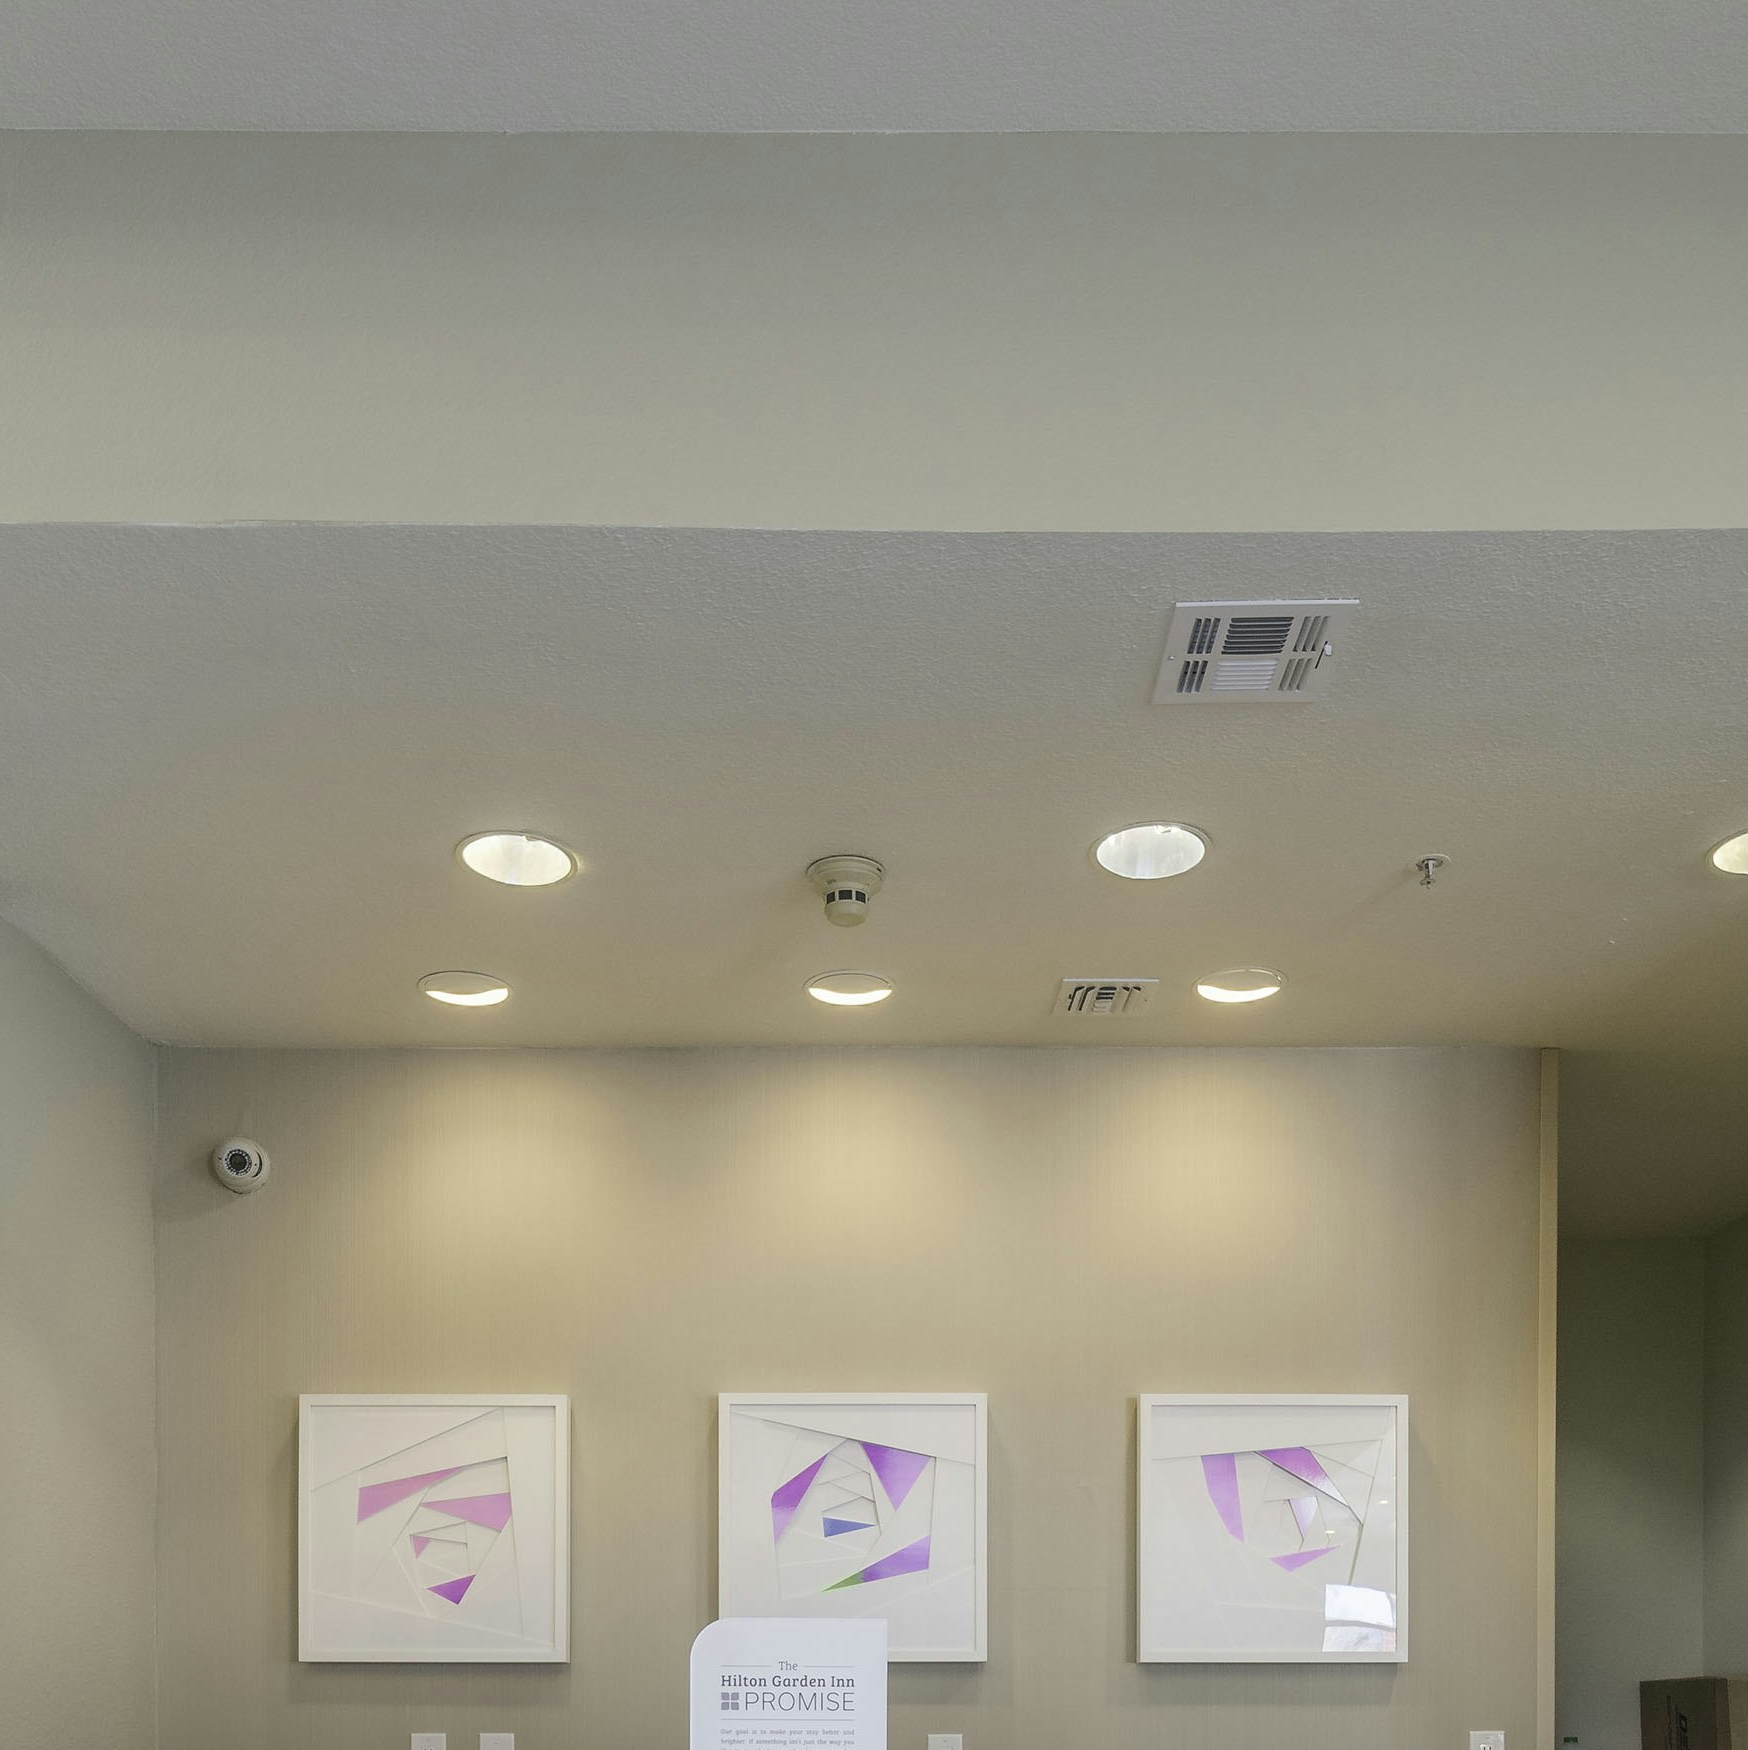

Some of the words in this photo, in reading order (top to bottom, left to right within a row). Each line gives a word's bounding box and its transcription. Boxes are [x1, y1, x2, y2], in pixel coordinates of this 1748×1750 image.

[778, 1660, 798, 1671] The
[721, 1674, 767, 1687] Hilton
[772, 1675, 826, 1687] Garden
[831, 1676, 855, 1688] Inn
[745, 1691, 855, 1711] PROMISE
